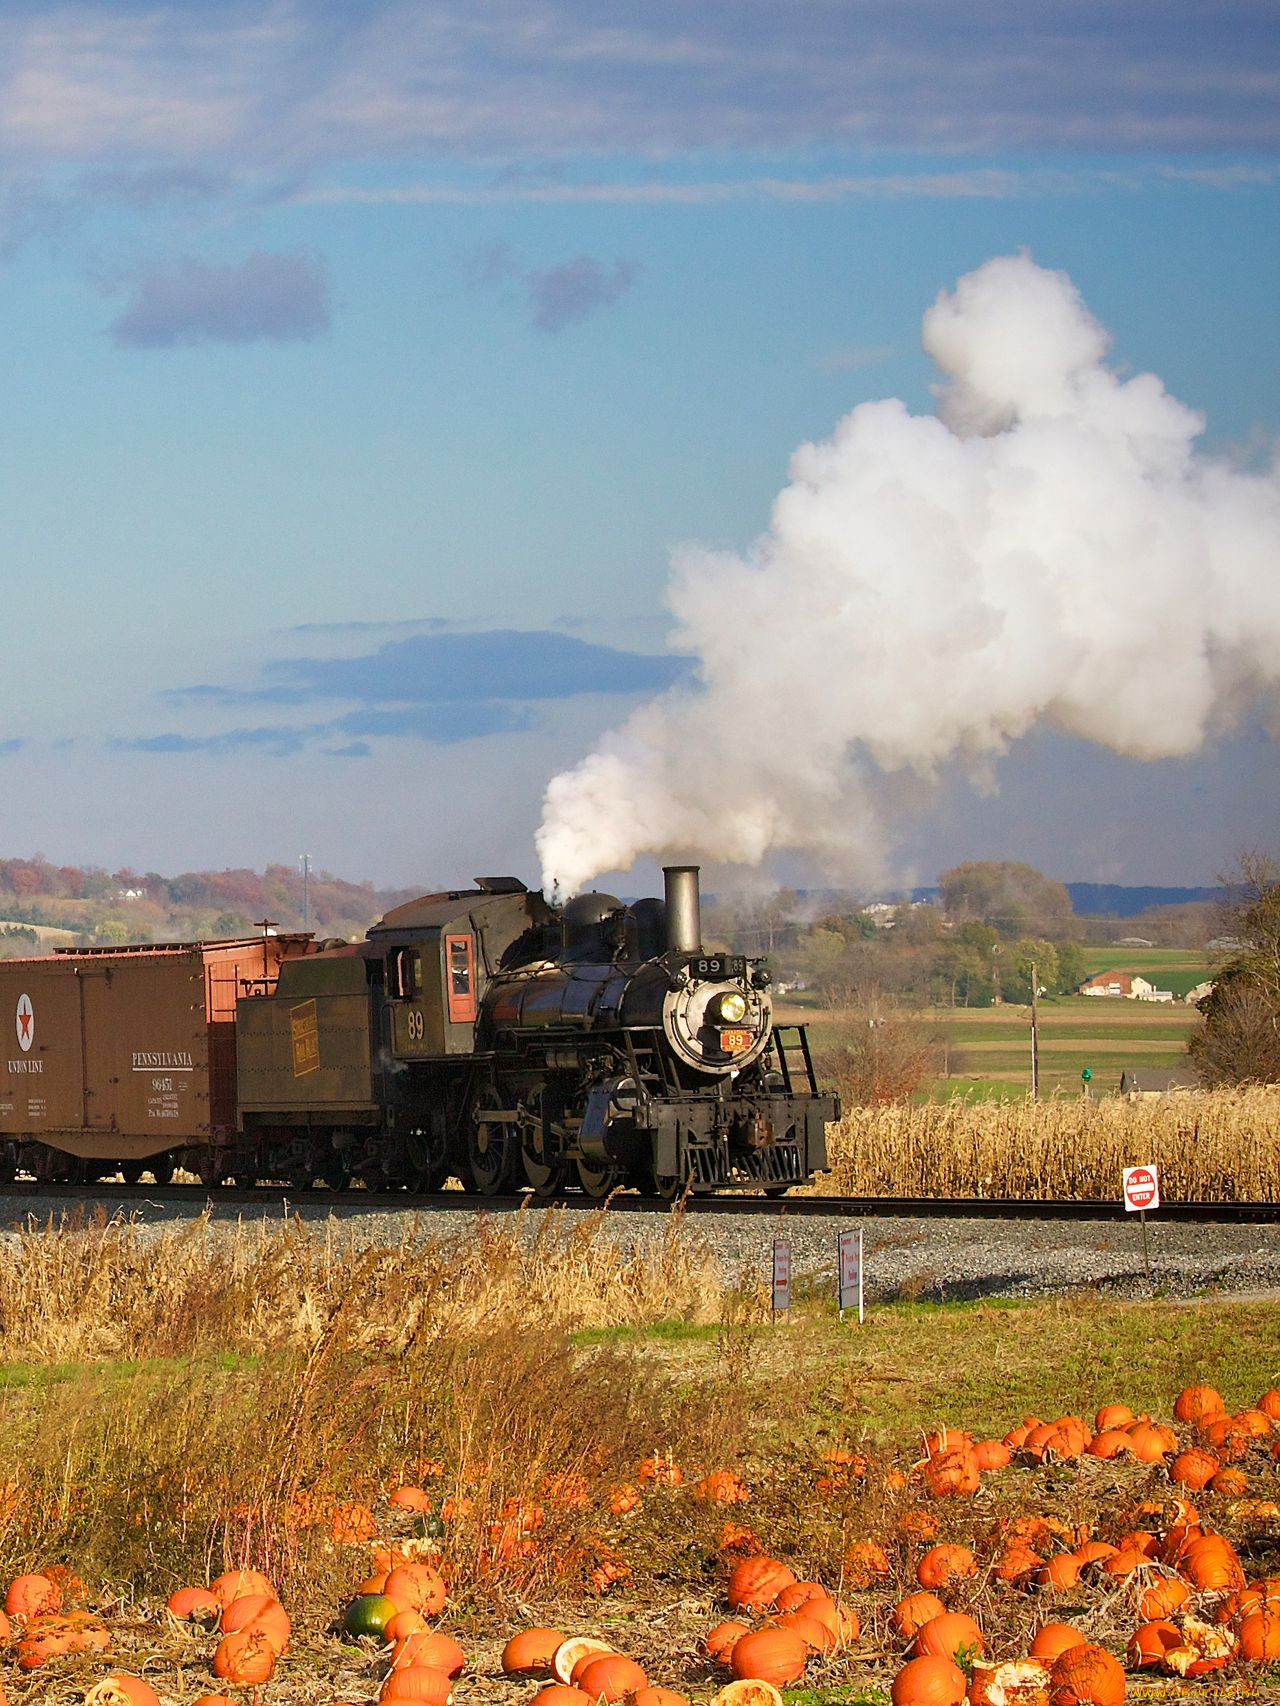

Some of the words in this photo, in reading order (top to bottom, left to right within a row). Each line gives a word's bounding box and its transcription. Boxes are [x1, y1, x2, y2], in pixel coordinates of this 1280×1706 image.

[699, 960, 720, 973] 89
[733, 960, 743, 971] 89
[408, 1011, 424, 1040] 89
[728, 1035, 743, 1045] 89
[132, 1052, 193, 1066] PENNSYLVANIA
[8, 1061, 28, 1073] UNION
[28, 1061, 44, 1073] LINE
[1139, 1175, 1151, 1183] NOT
[1132, 1192, 1151, 1201] ENTER
